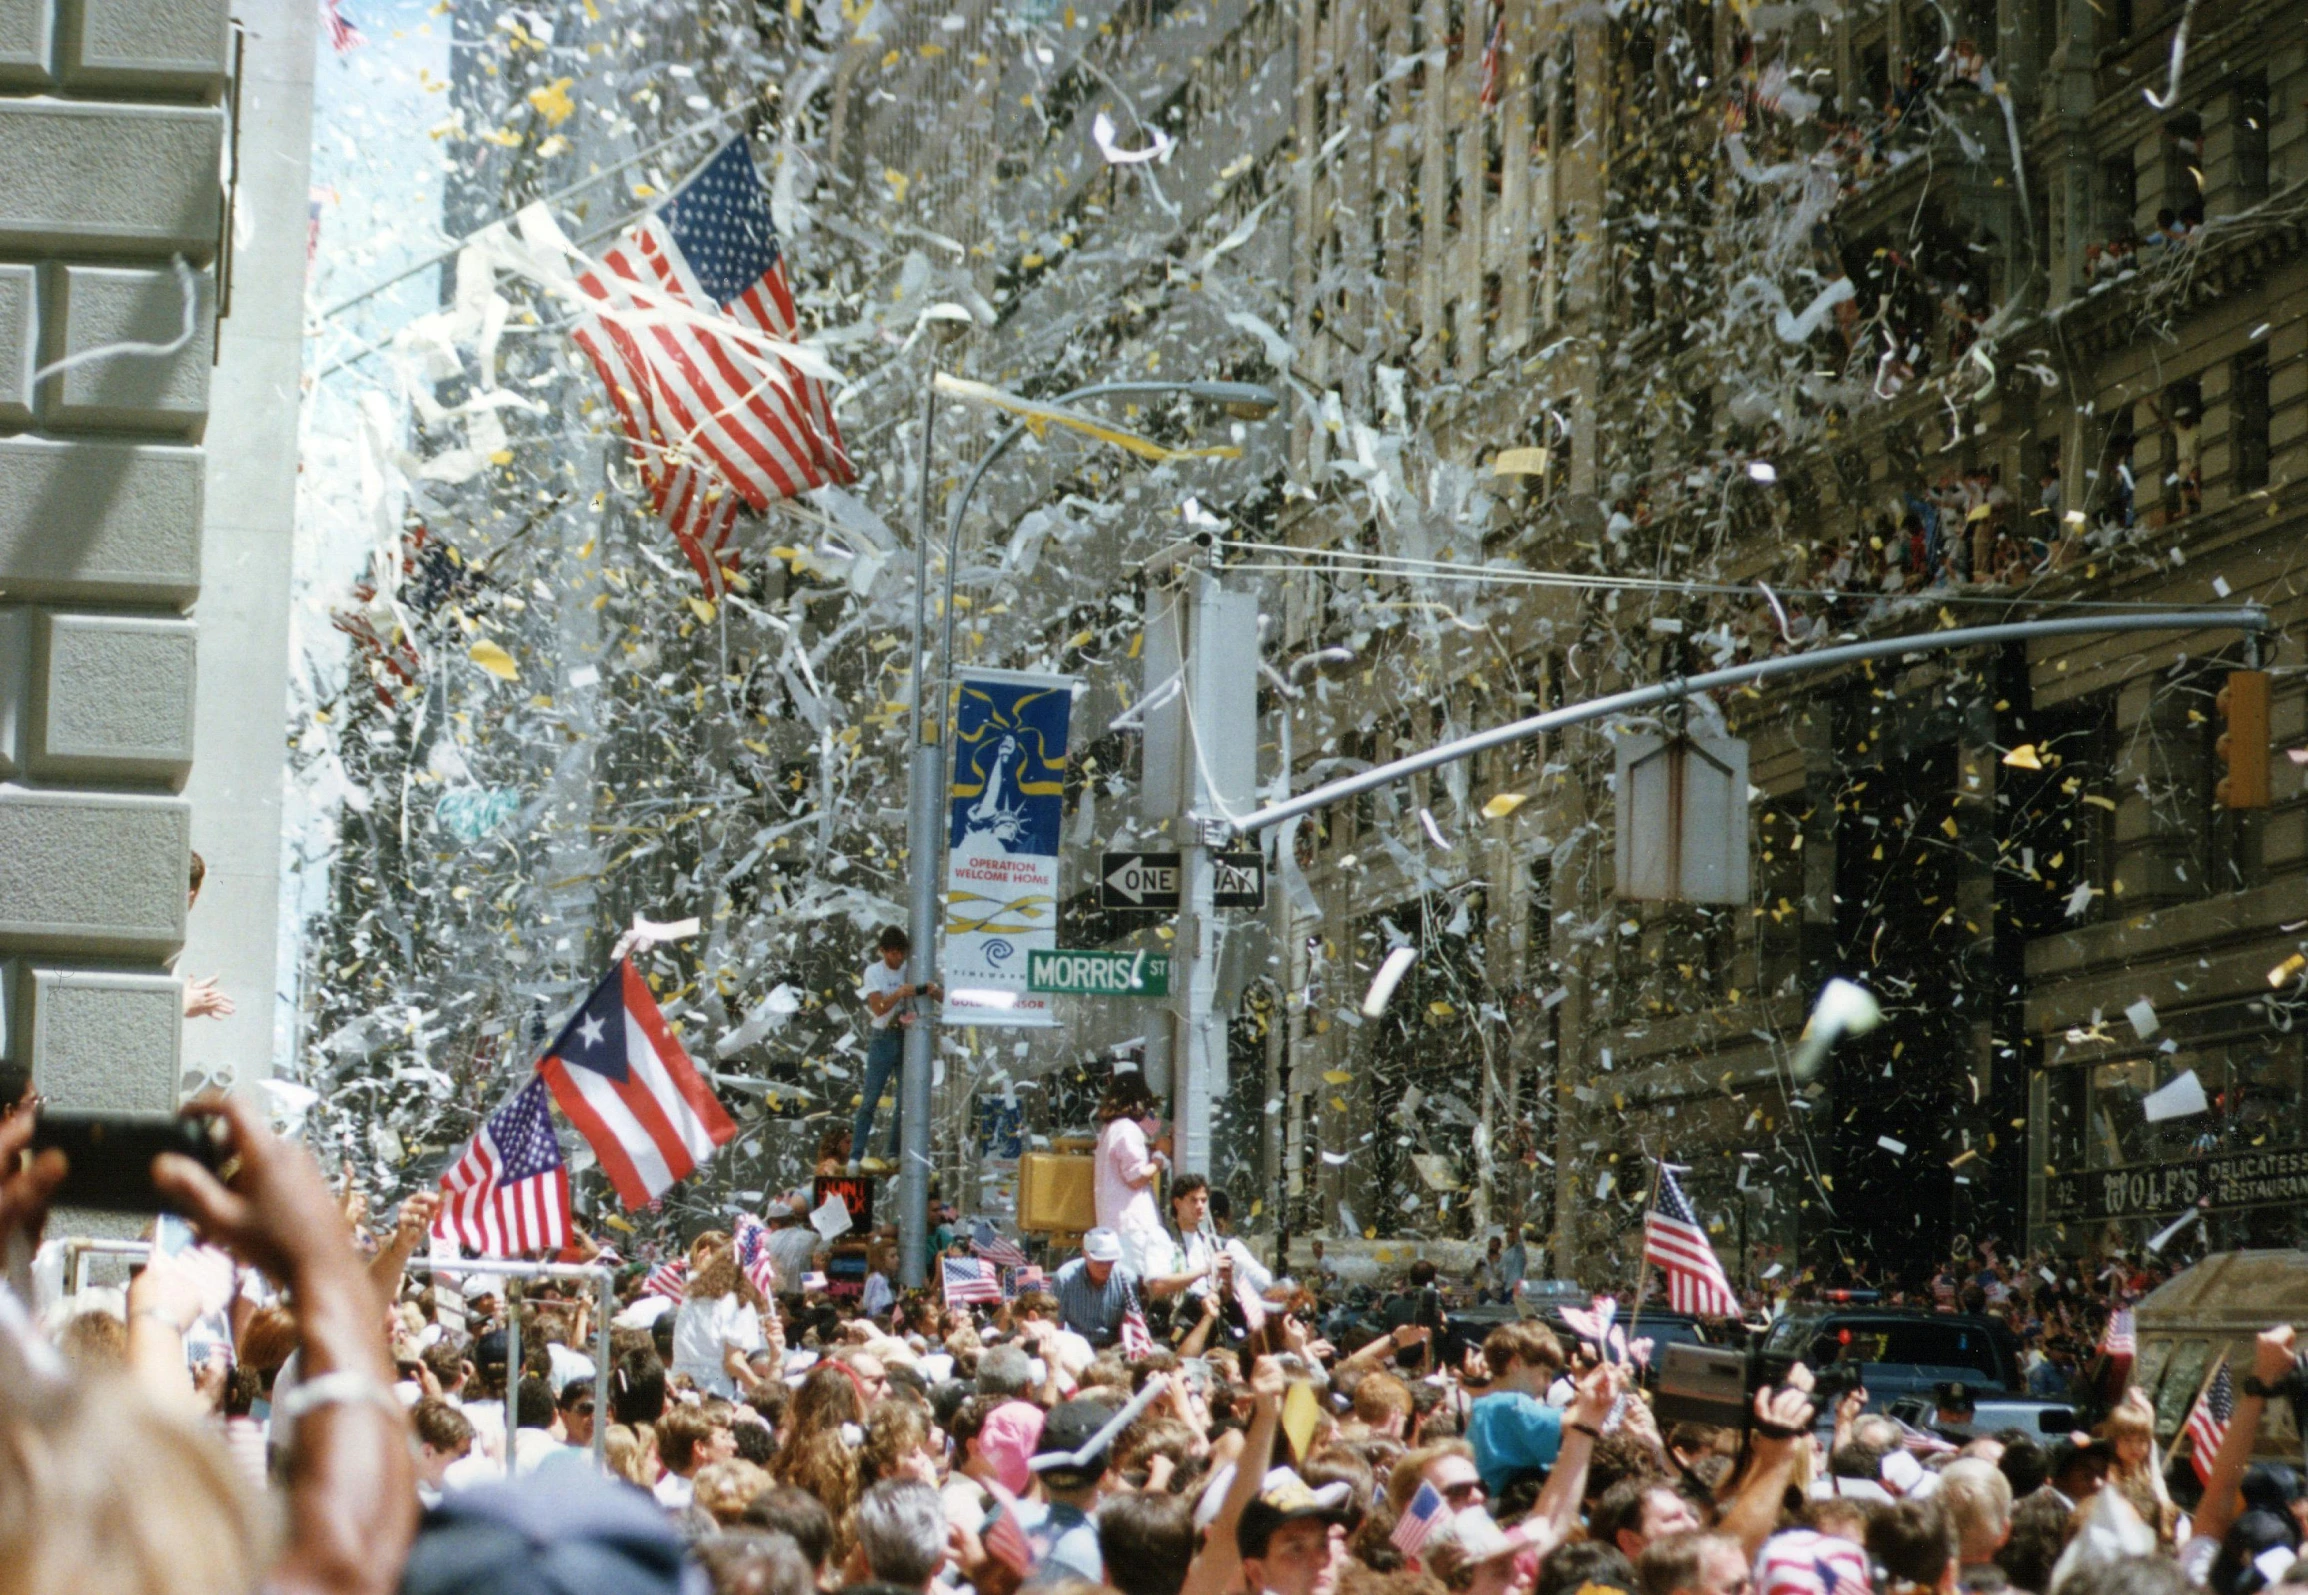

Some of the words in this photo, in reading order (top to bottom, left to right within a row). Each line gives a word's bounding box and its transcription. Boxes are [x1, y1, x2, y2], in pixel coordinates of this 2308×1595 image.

[969, 857, 1036, 872] OPERATION
[955, 868, 1008, 882] WELCOME
[1013, 873, 1049, 885] HOME
[1125, 870, 1173, 890] ONE
[1033, 955, 1131, 989] MORRIS
[1149, 960, 1167, 976] ST
[2103, 1167, 2198, 1214] WOLF'S
